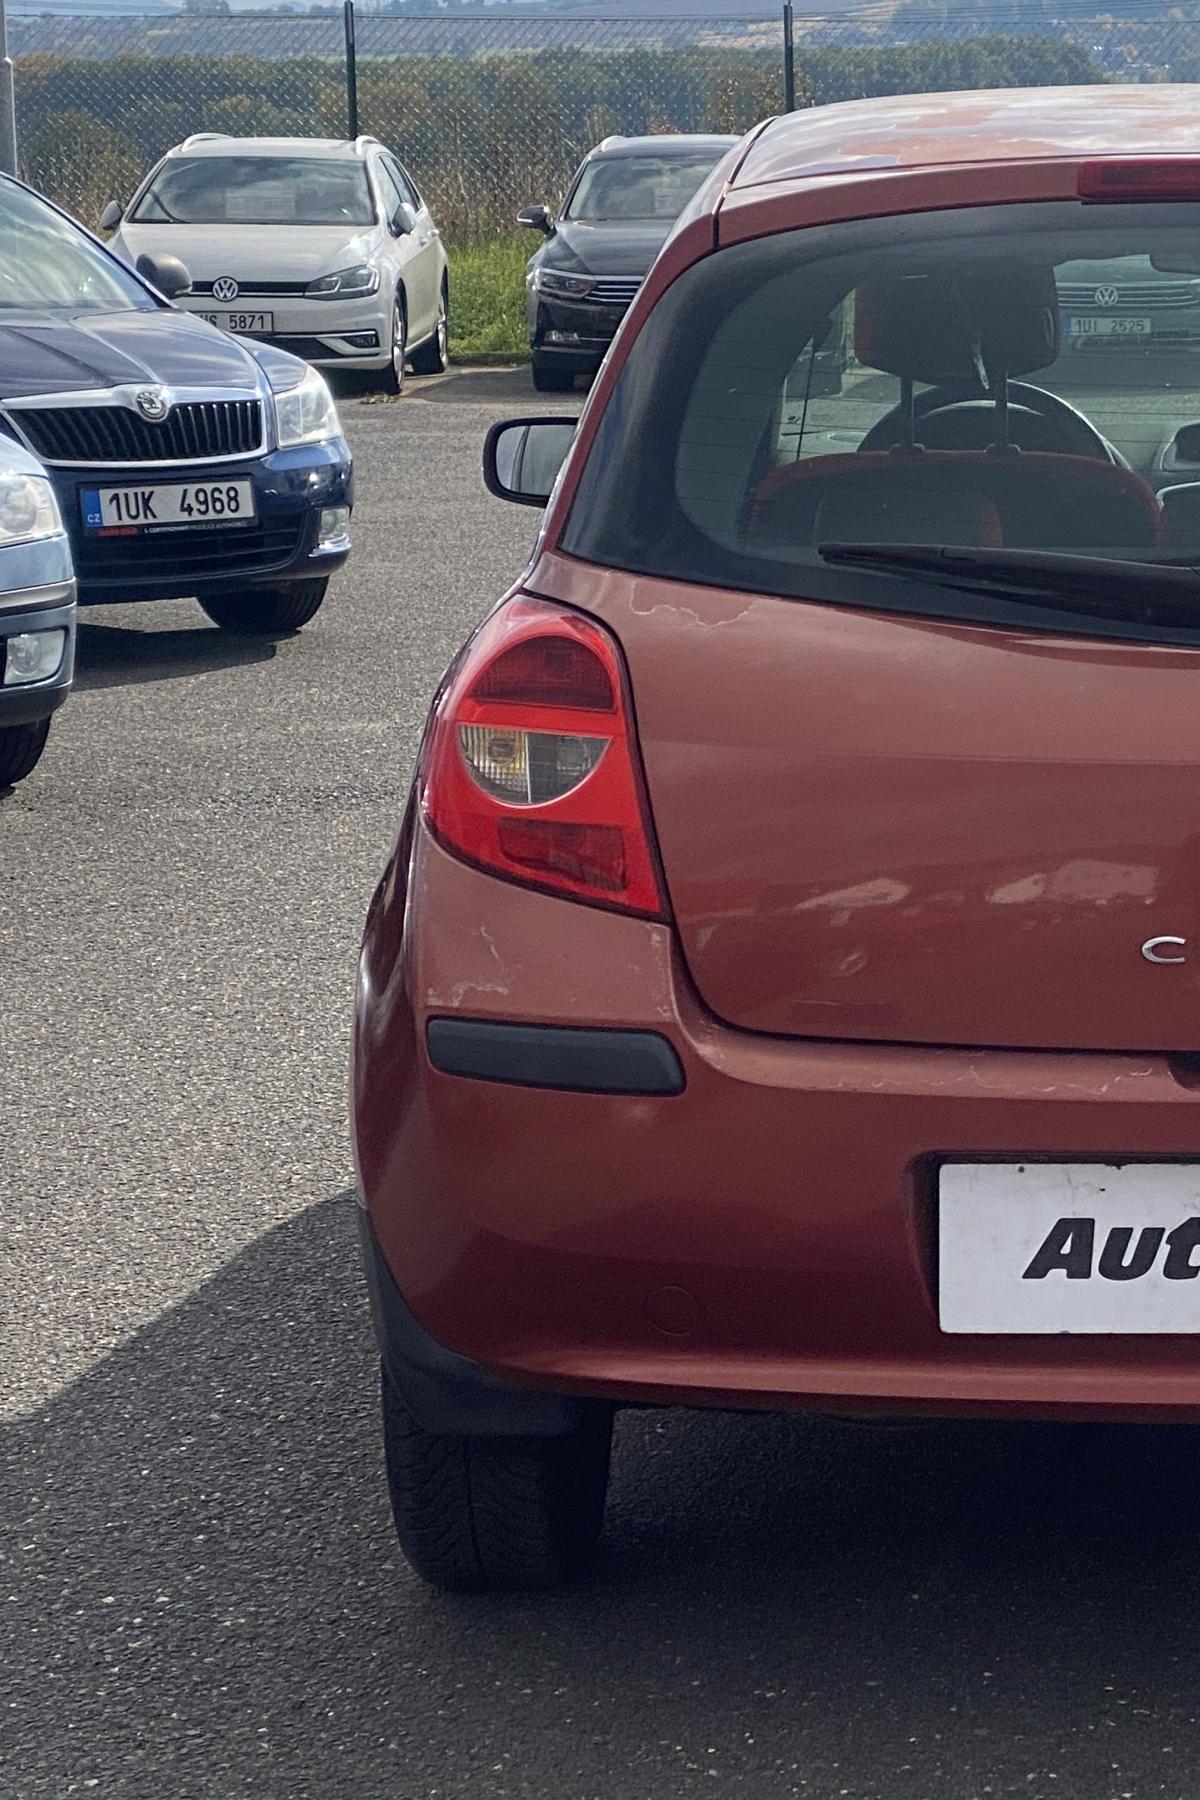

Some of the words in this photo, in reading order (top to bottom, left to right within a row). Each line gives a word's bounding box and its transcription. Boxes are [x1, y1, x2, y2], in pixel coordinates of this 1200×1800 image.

[229, 314, 264, 329] 5871
[87, 513, 100, 523] CZ
[109, 490, 157, 521] 1UK
[180, 486, 240, 517] 4968
